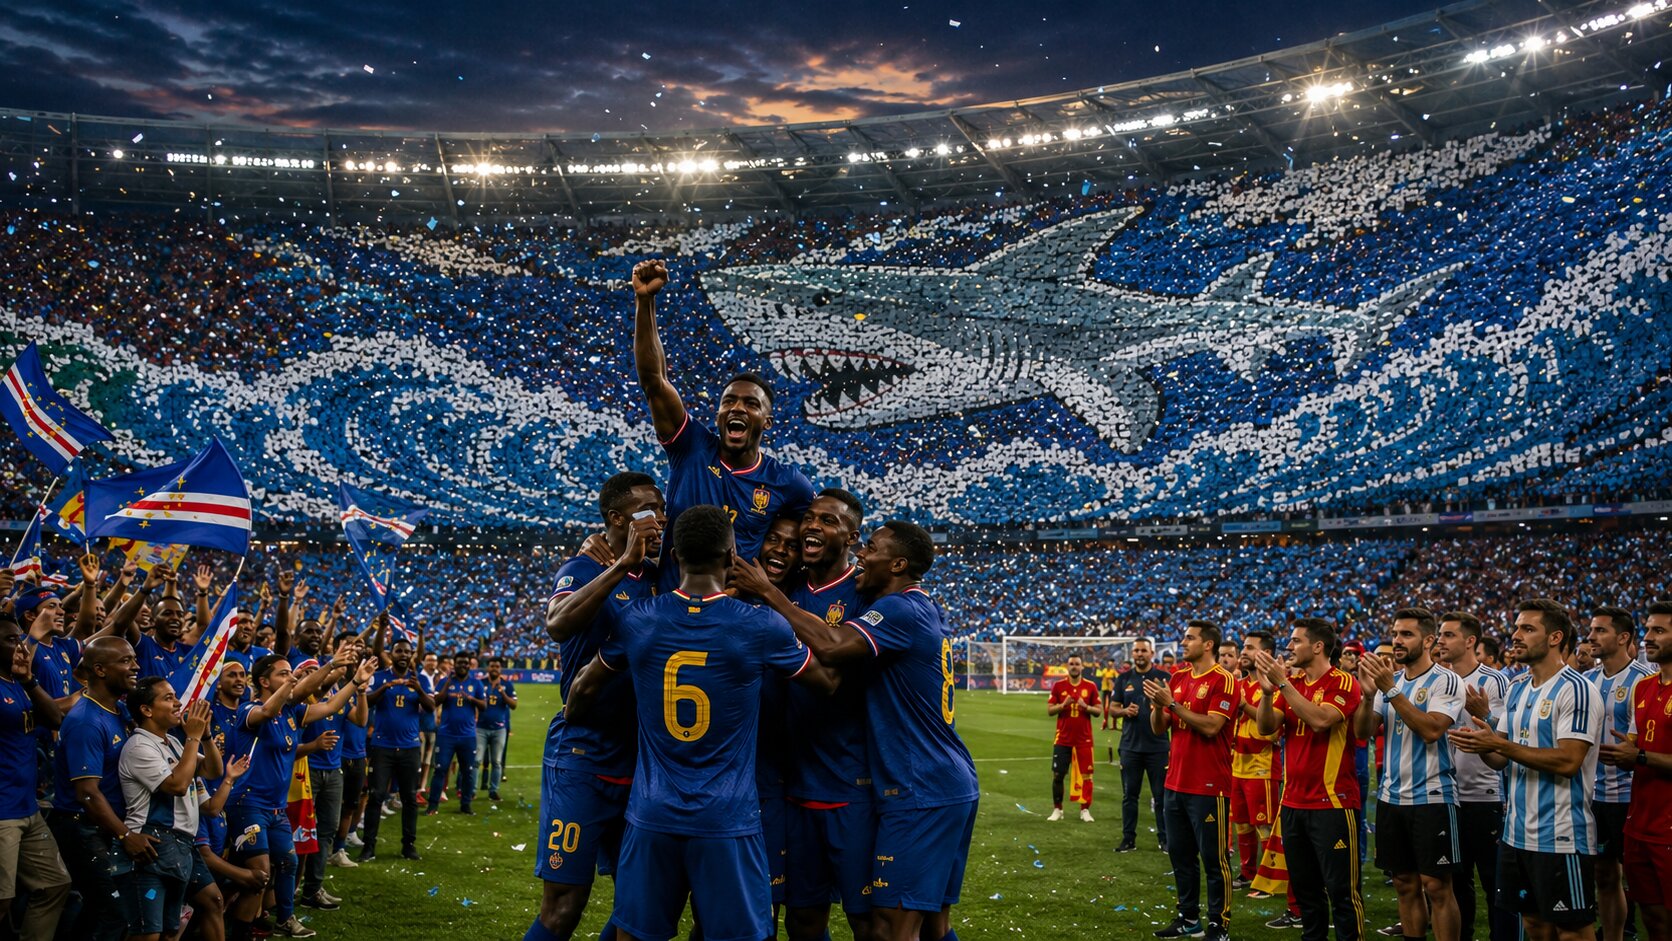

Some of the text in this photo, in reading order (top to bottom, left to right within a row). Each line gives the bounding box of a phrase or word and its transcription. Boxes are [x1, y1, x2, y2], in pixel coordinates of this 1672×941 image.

[663, 650, 711, 742] 6
[941, 637, 955, 725] 8
[548, 818, 581, 854] 20
